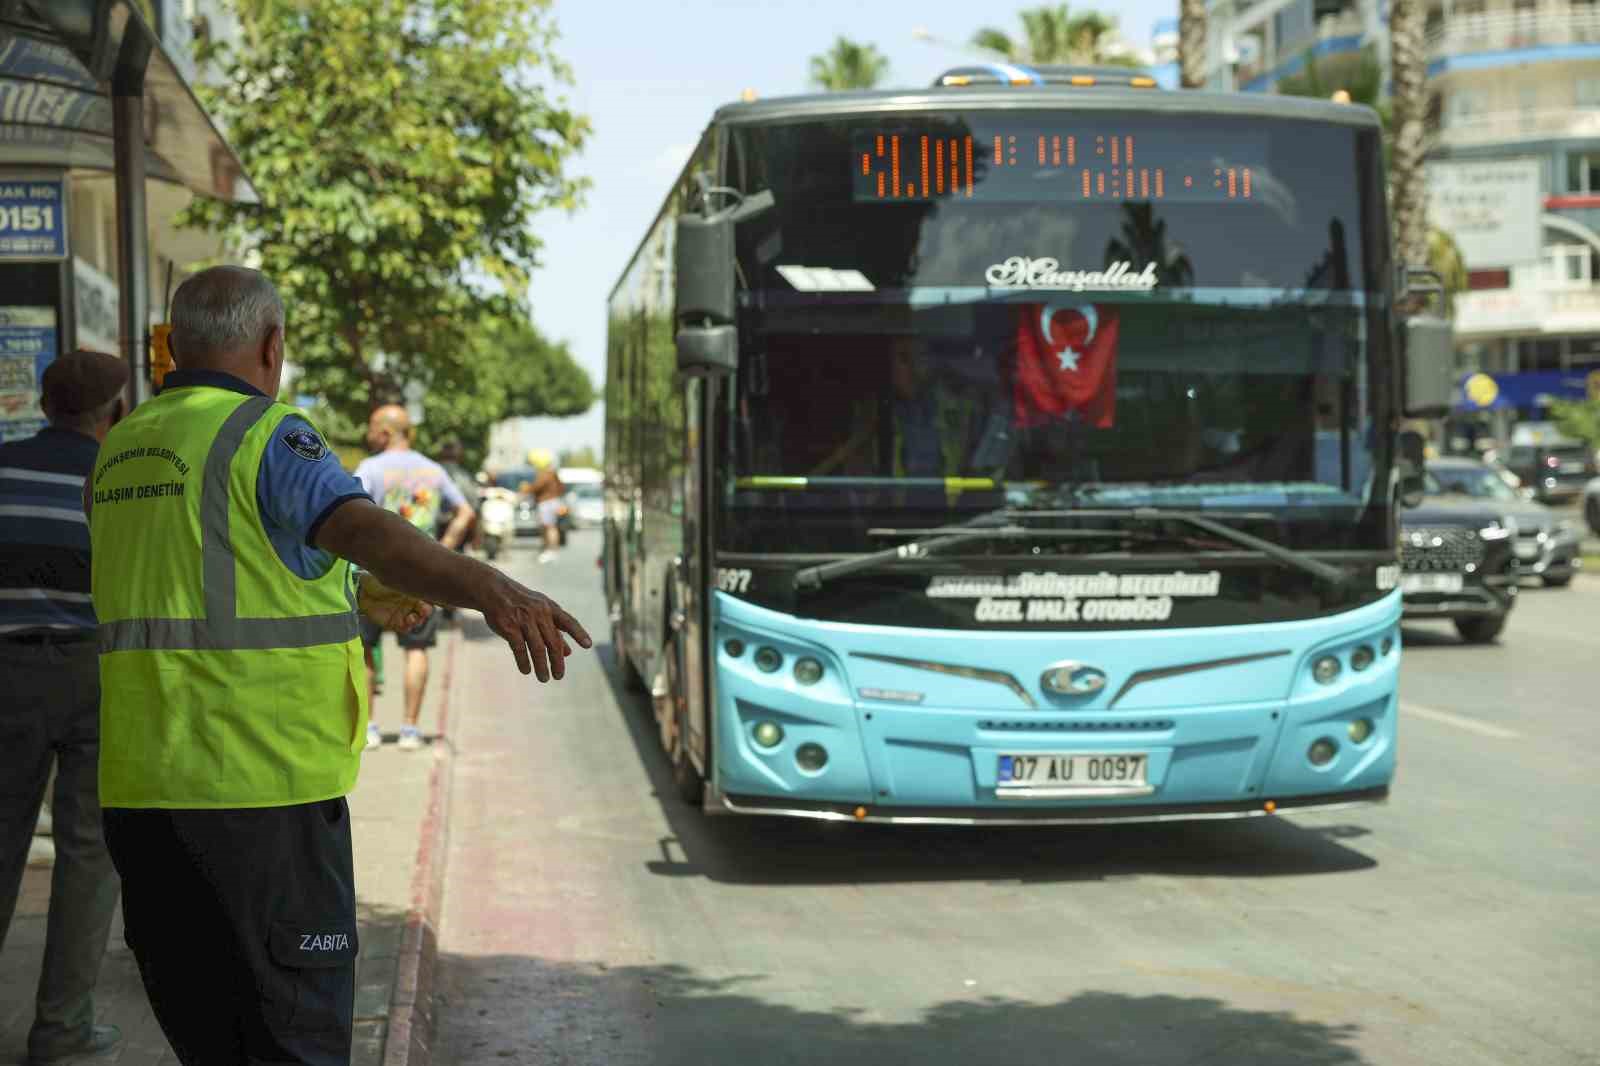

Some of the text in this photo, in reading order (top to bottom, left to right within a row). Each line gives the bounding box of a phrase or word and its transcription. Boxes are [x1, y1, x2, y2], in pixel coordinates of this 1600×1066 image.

[95, 480, 185, 504] ULAŞIM DENETİM
[974, 595, 1174, 622] ÖZEL HALK OTOBÜSÜ
[1013, 756, 1141, 781] 07 AU 0097
[299, 932, 350, 952] ZABITA
